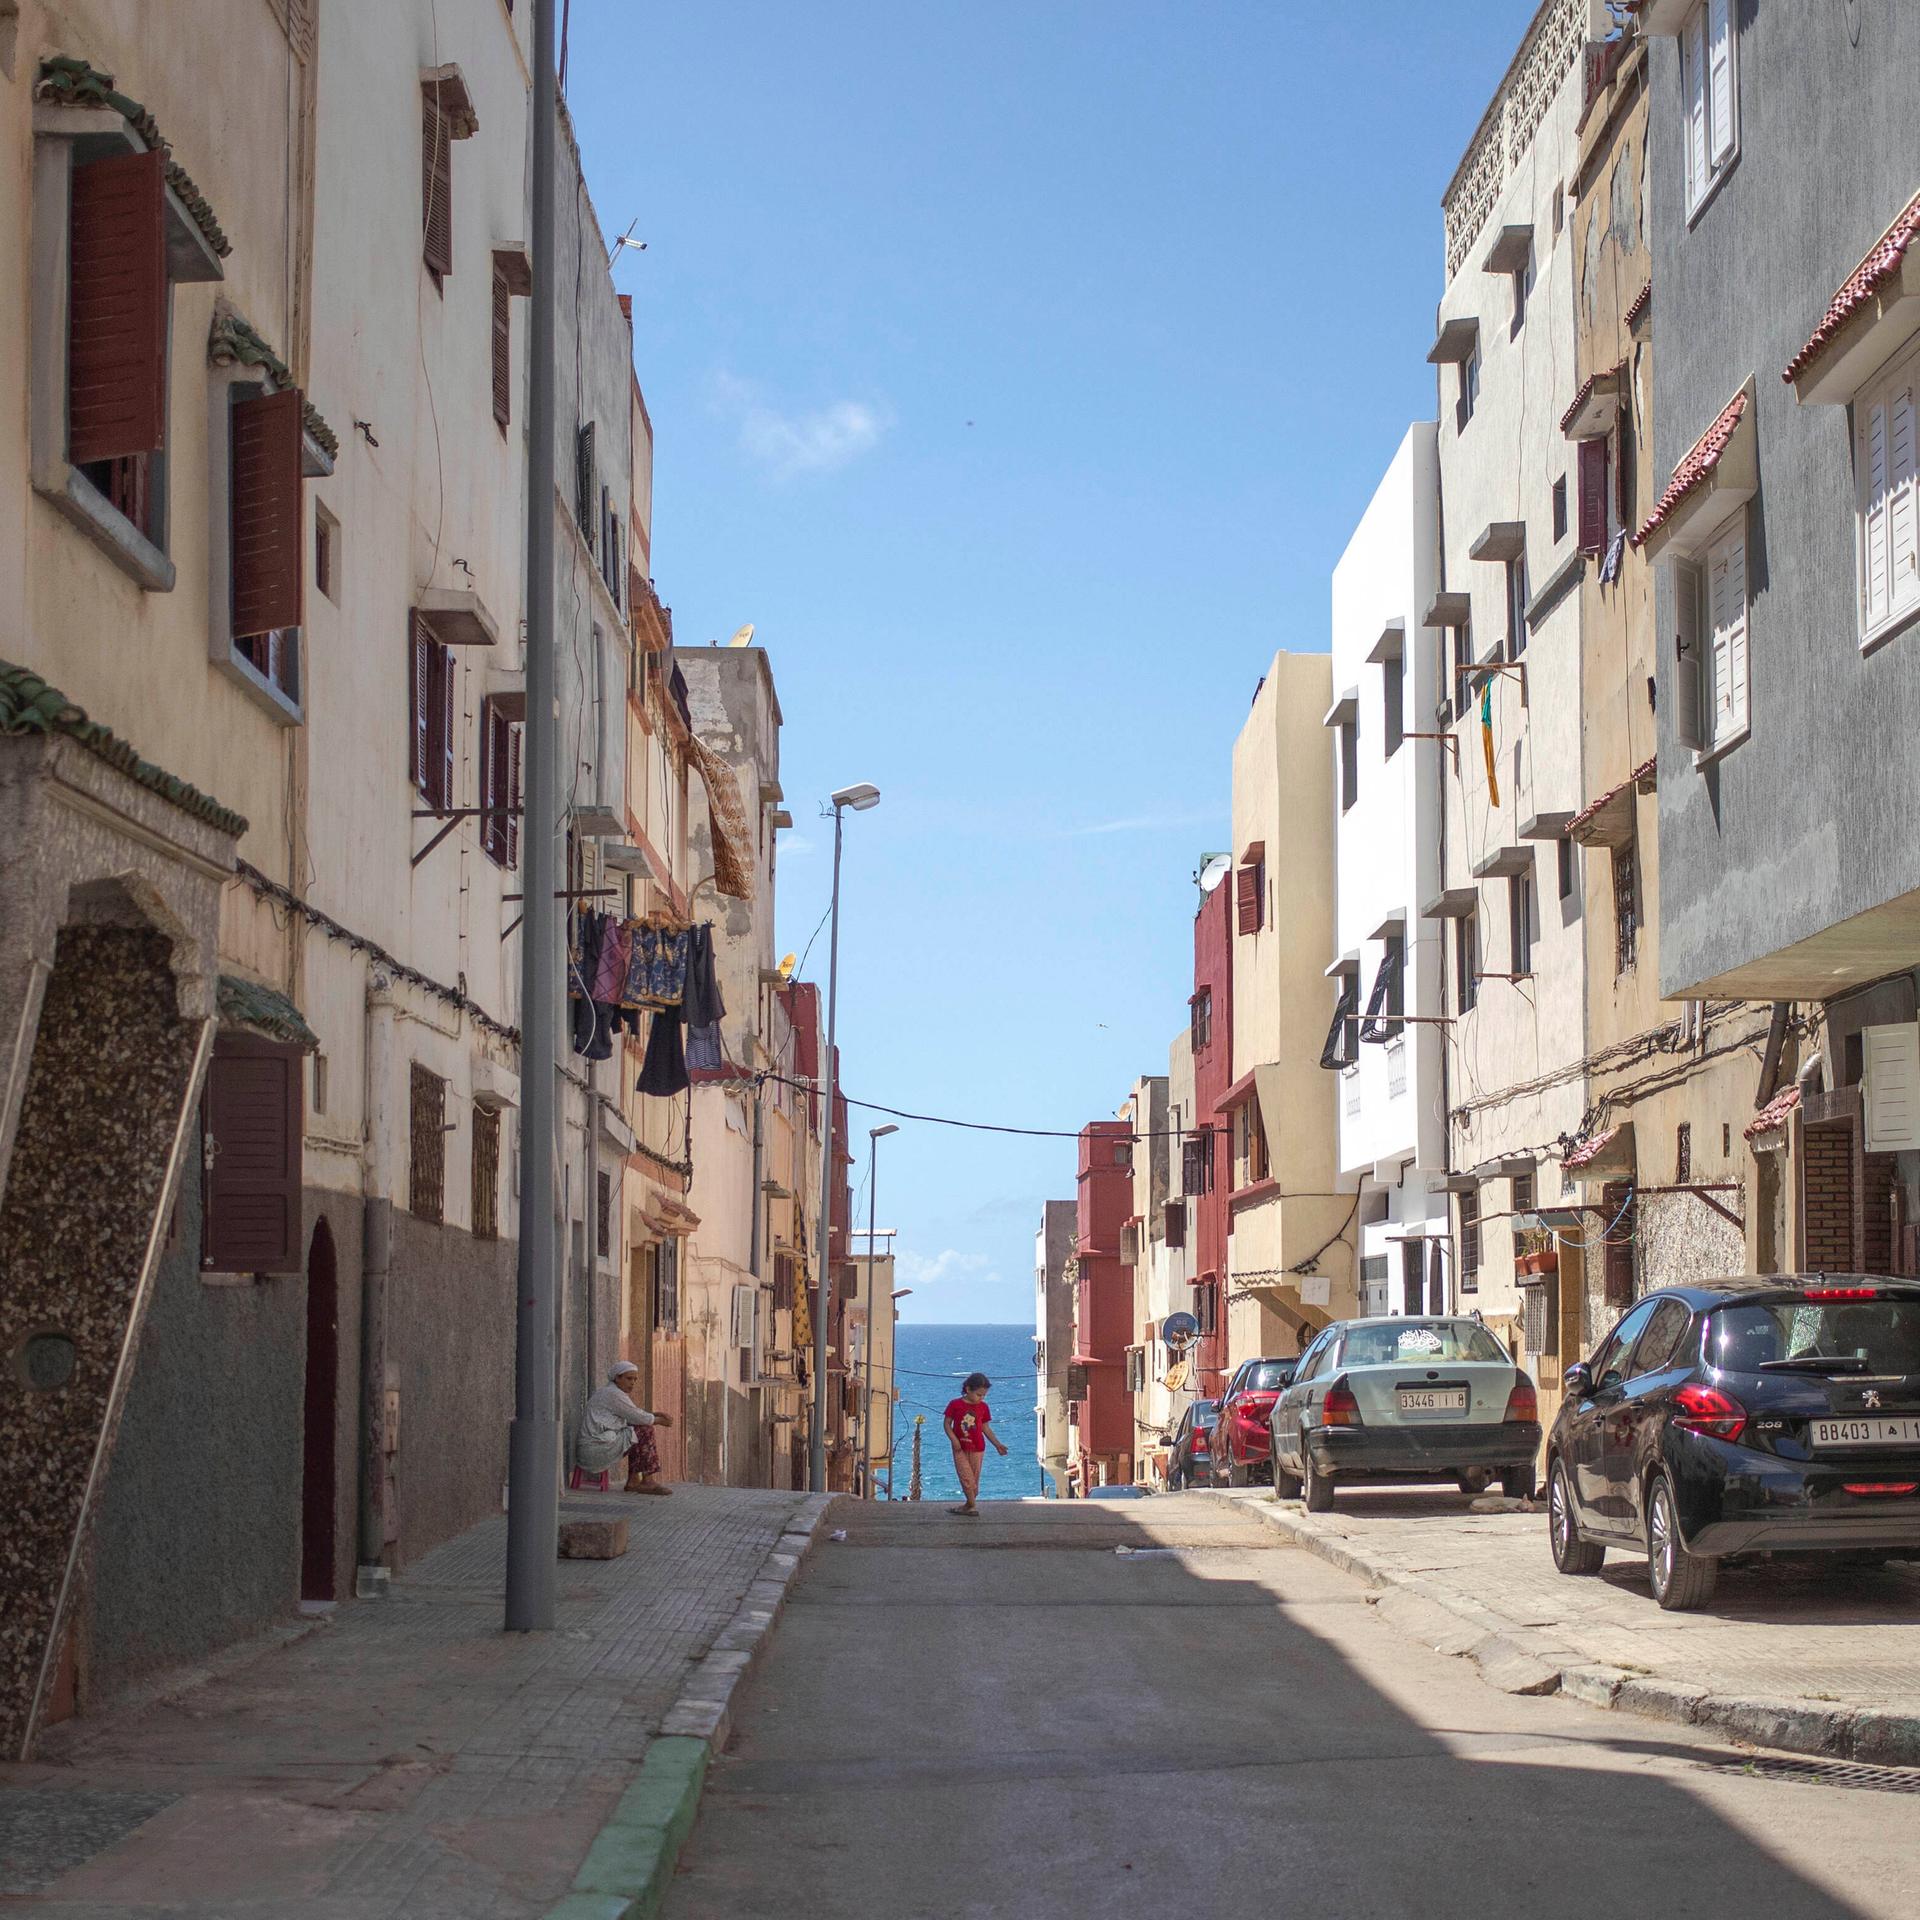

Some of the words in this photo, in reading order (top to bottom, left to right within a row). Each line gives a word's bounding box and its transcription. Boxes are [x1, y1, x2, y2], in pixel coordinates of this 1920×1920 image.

[1402, 1393, 1434, 1408] 33446
[1458, 1393, 1464, 1407] 8
[1756, 1421, 1783, 1429] 208
[1819, 1422, 1870, 1441] 88403
